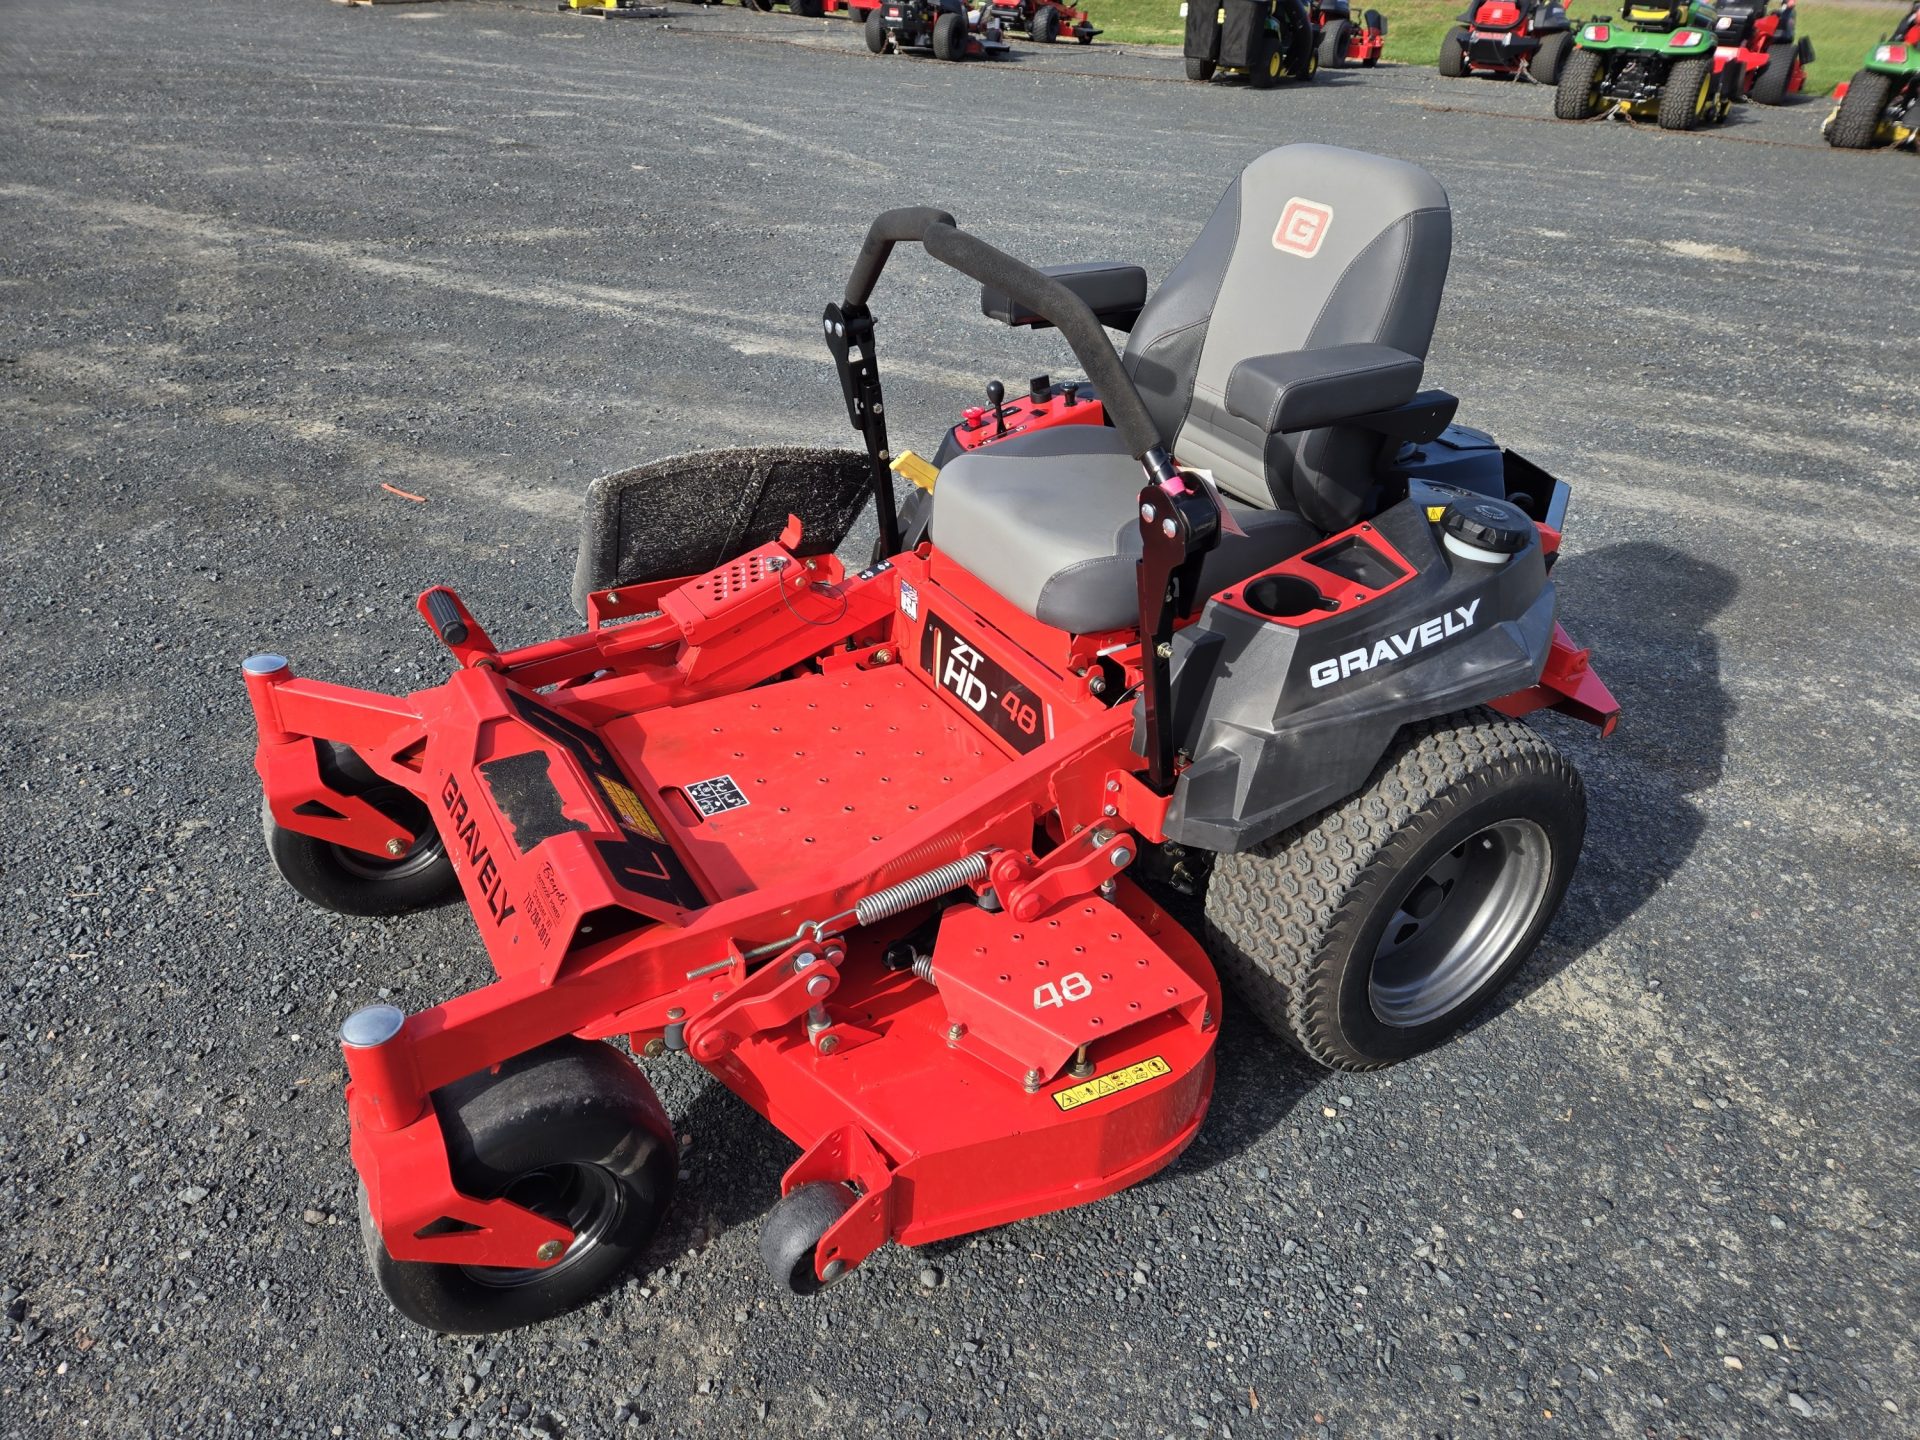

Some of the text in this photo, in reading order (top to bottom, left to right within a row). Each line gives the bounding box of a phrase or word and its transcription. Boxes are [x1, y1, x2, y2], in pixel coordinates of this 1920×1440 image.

[950, 636, 984, 672] ZT
[1309, 598, 1481, 689] GRAVELY
[441, 772, 516, 928] GRAVELY
[1033, 971, 1093, 1010] 48
